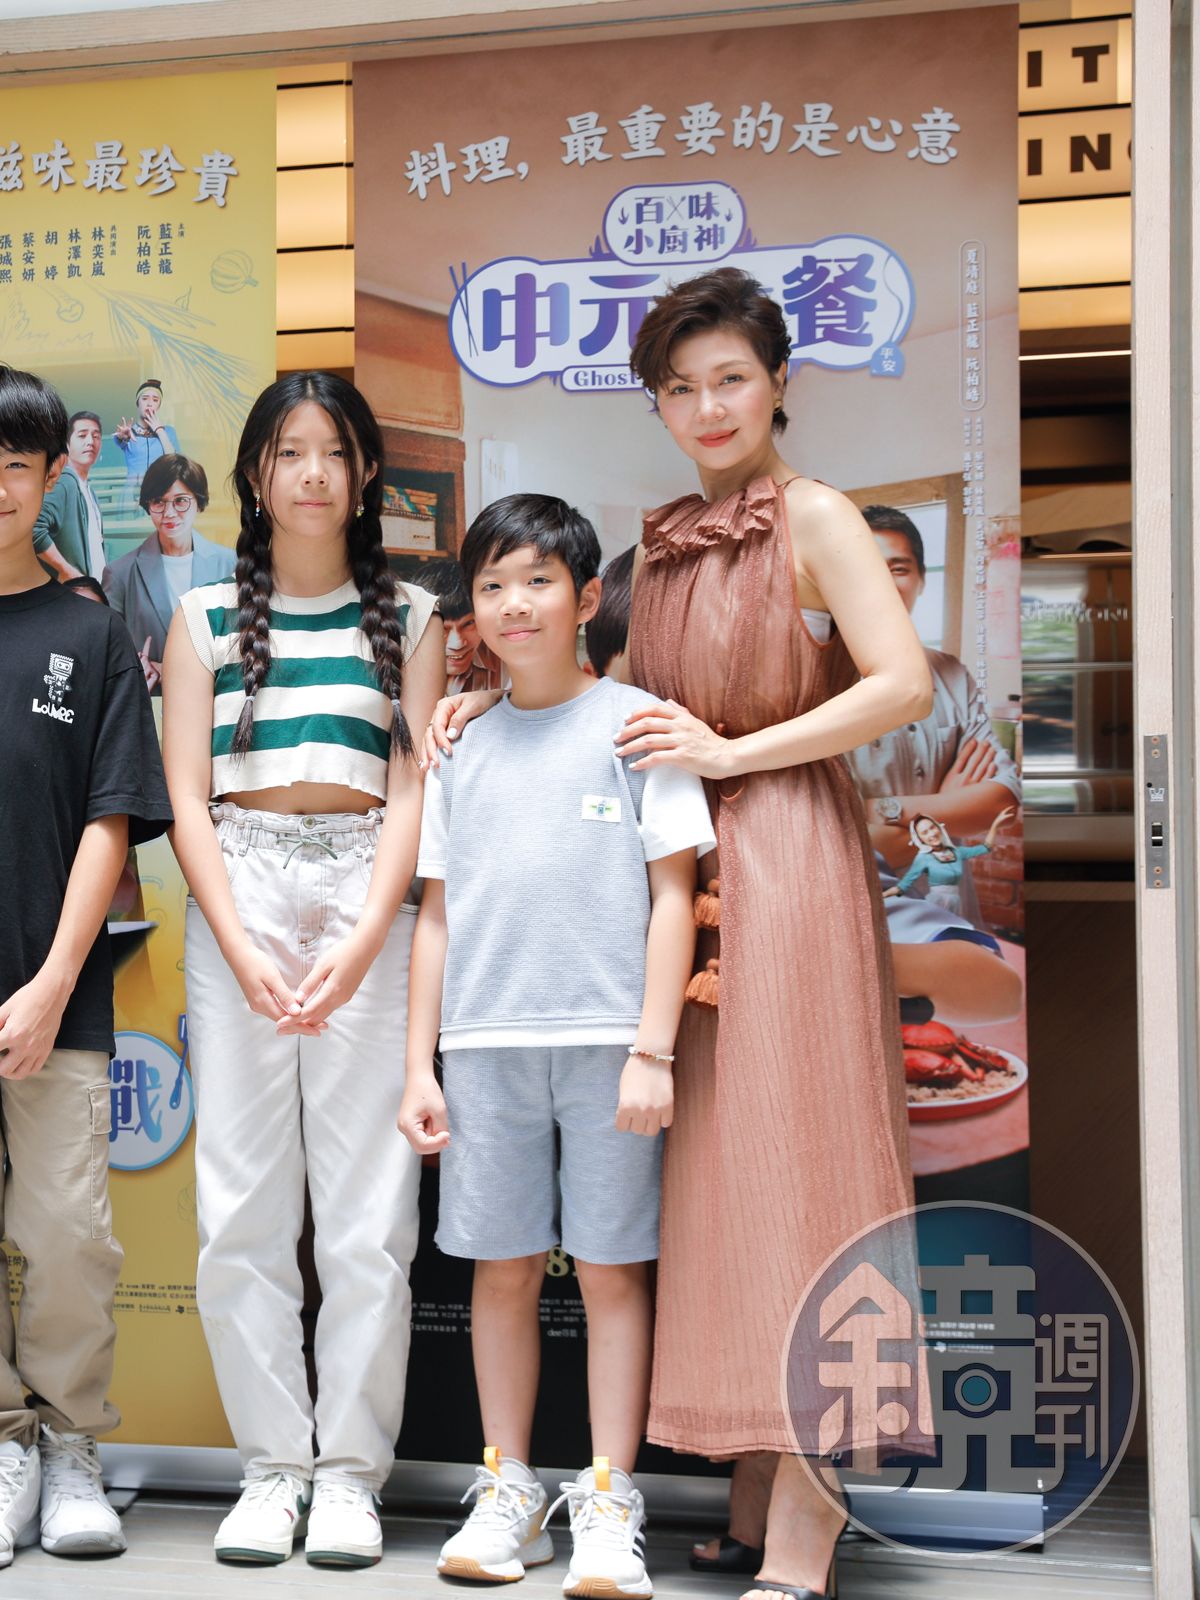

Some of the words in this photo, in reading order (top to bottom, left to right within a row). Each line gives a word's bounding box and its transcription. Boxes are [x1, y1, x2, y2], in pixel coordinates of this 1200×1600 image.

[1027, 133, 1132, 176] IN
[136, 225, 151, 275] 阮柏皓
[158, 222, 173, 275] 藍正龍
[623, 223, 725, 255] 小廚神
[482, 253, 878, 368] 中元餐
